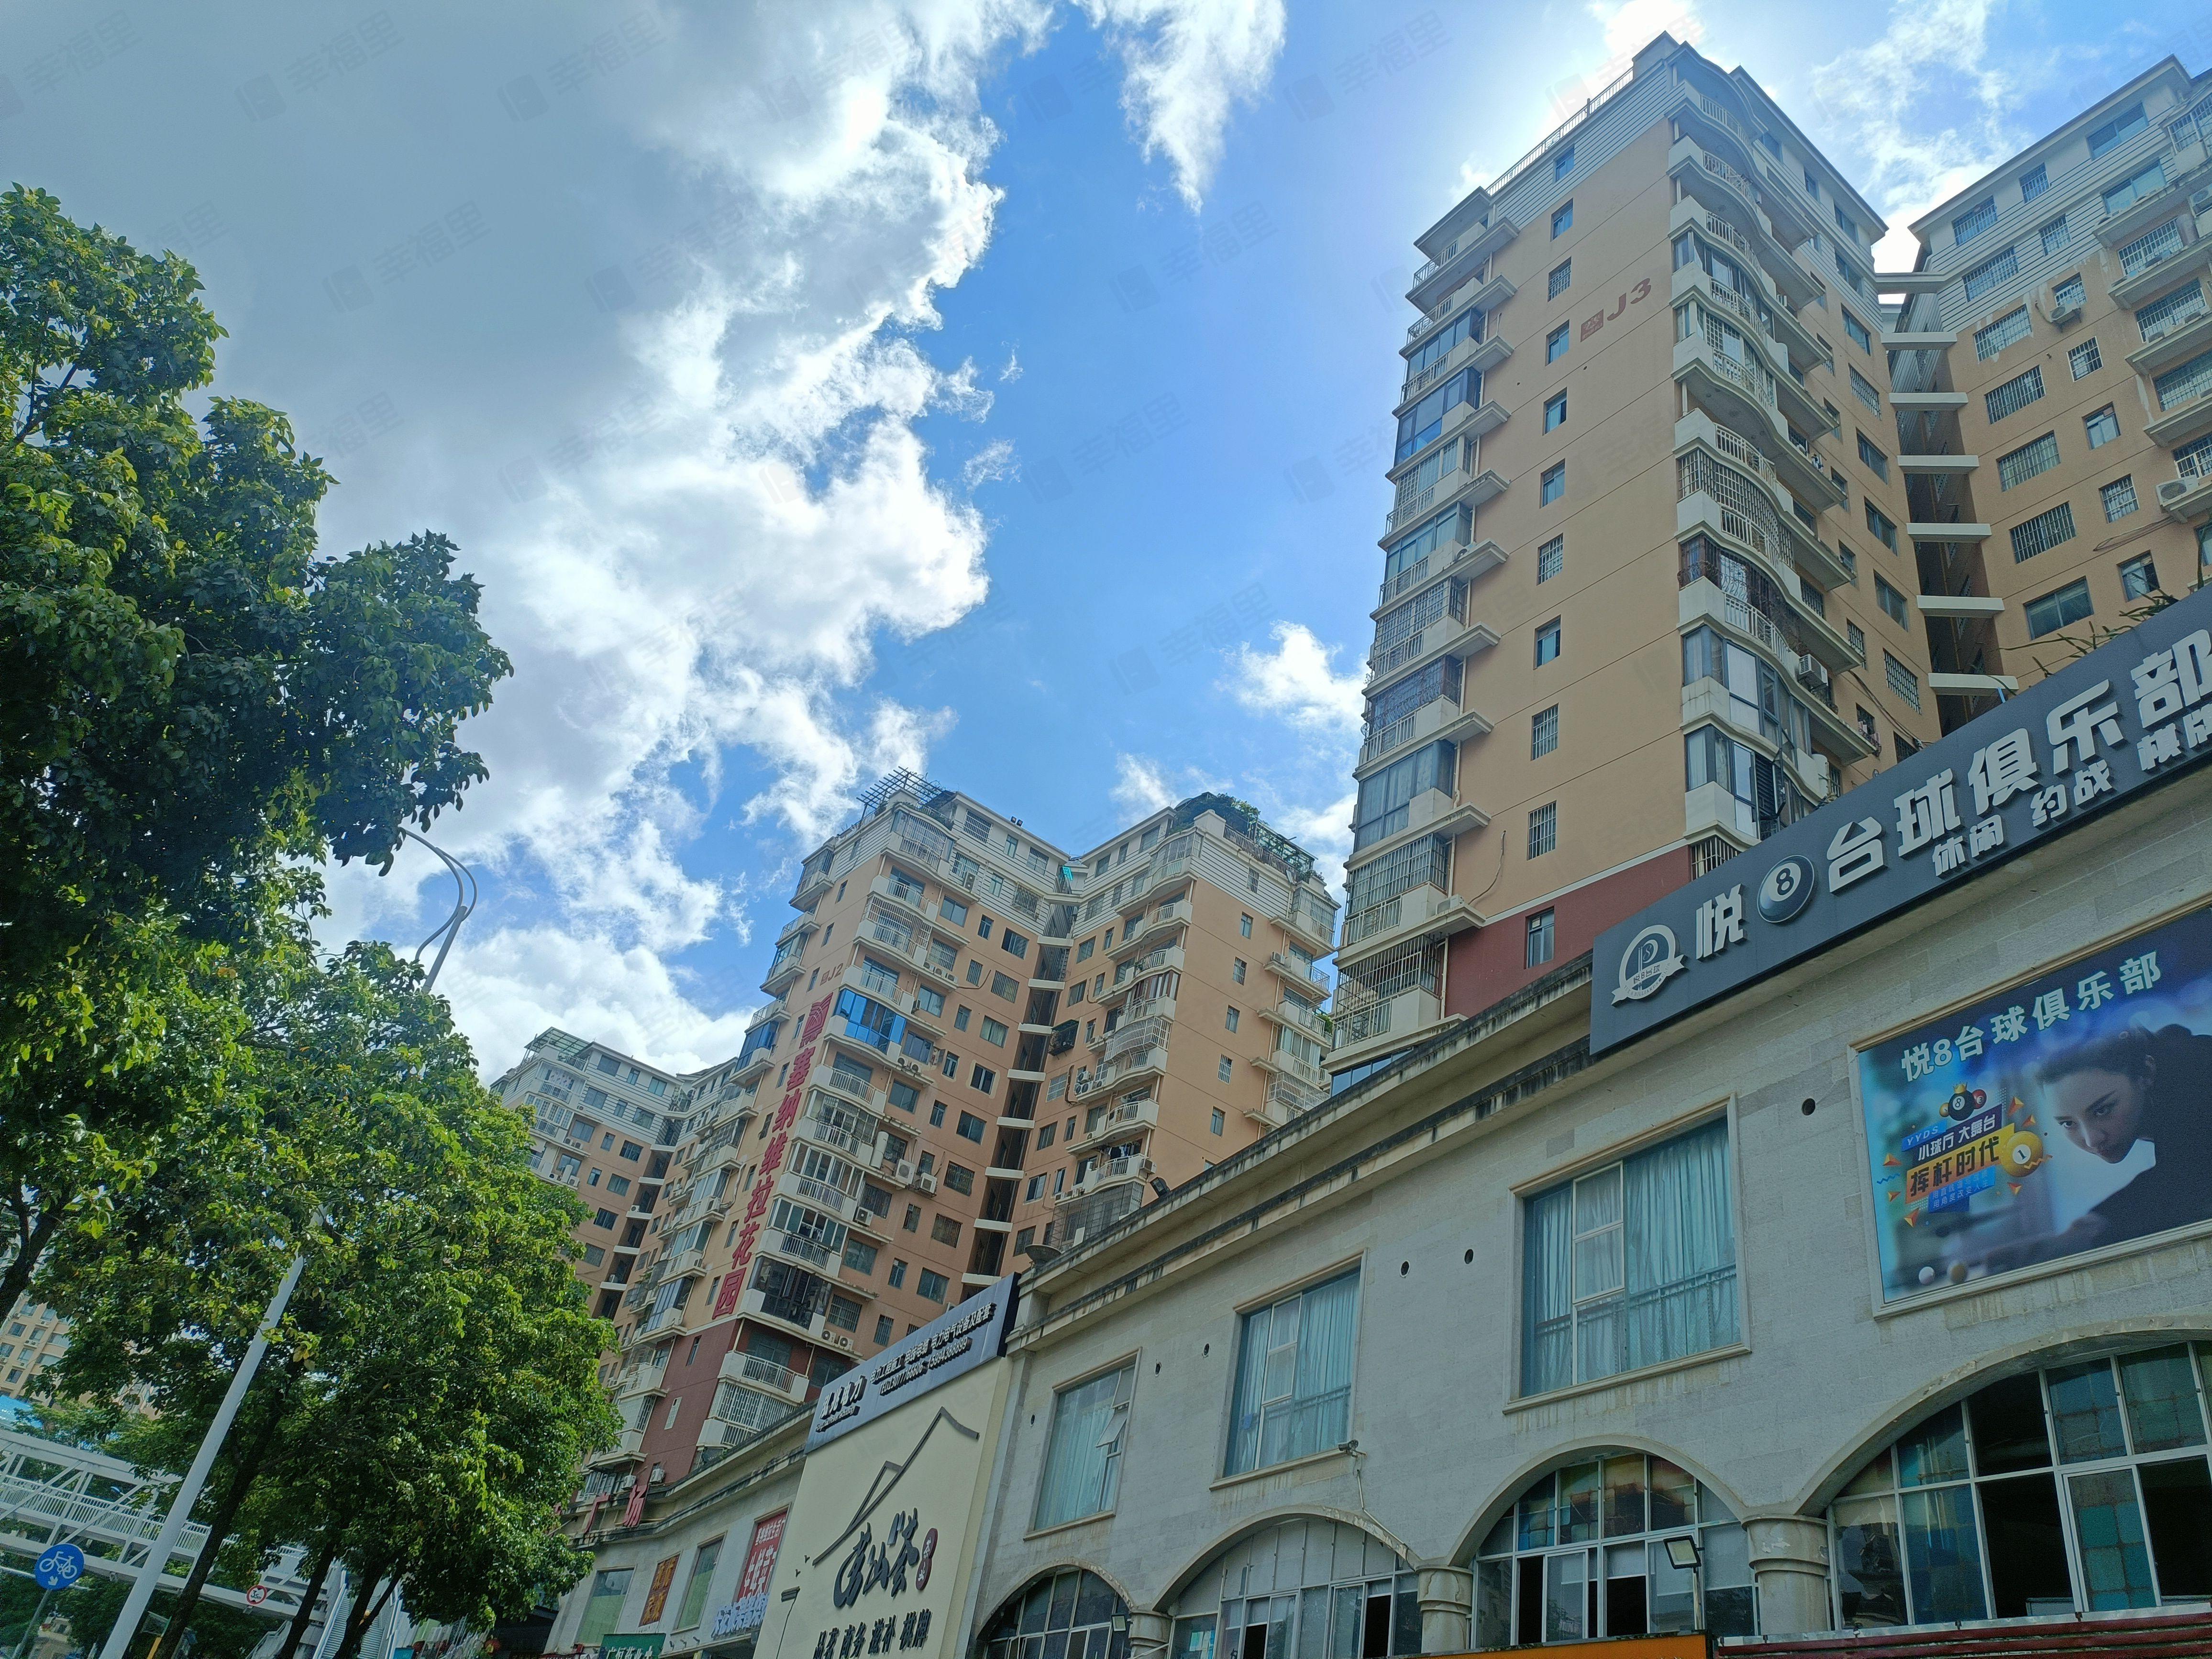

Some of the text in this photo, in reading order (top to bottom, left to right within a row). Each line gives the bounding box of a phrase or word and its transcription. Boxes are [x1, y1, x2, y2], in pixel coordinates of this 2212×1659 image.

[1607, 278, 1651, 321] J3
[1933, 814, 2004, 877] 休闲
[2031, 759, 2113, 828] 约战
[828, 963, 843, 981] J2
[1901, 951, 2162, 1082] 悦8台球俱乐部
[1907, 1126, 1939, 1146] YYDS
[1918, 1114, 1995, 1161] 小球厅 大舞台
[2018, 1150, 2027, 1160] 1
[712, 1046, 815, 1320] 塞纳维拉花园
[1910, 1136, 1999, 1197] 挥杆时代
[870, 1302, 992, 1383] 电力工程施工 电线电缆 电力电气设备及配套
[839, 1622, 866, 1659] 商务
[899, 1608, 932, 1650] 棋牌
